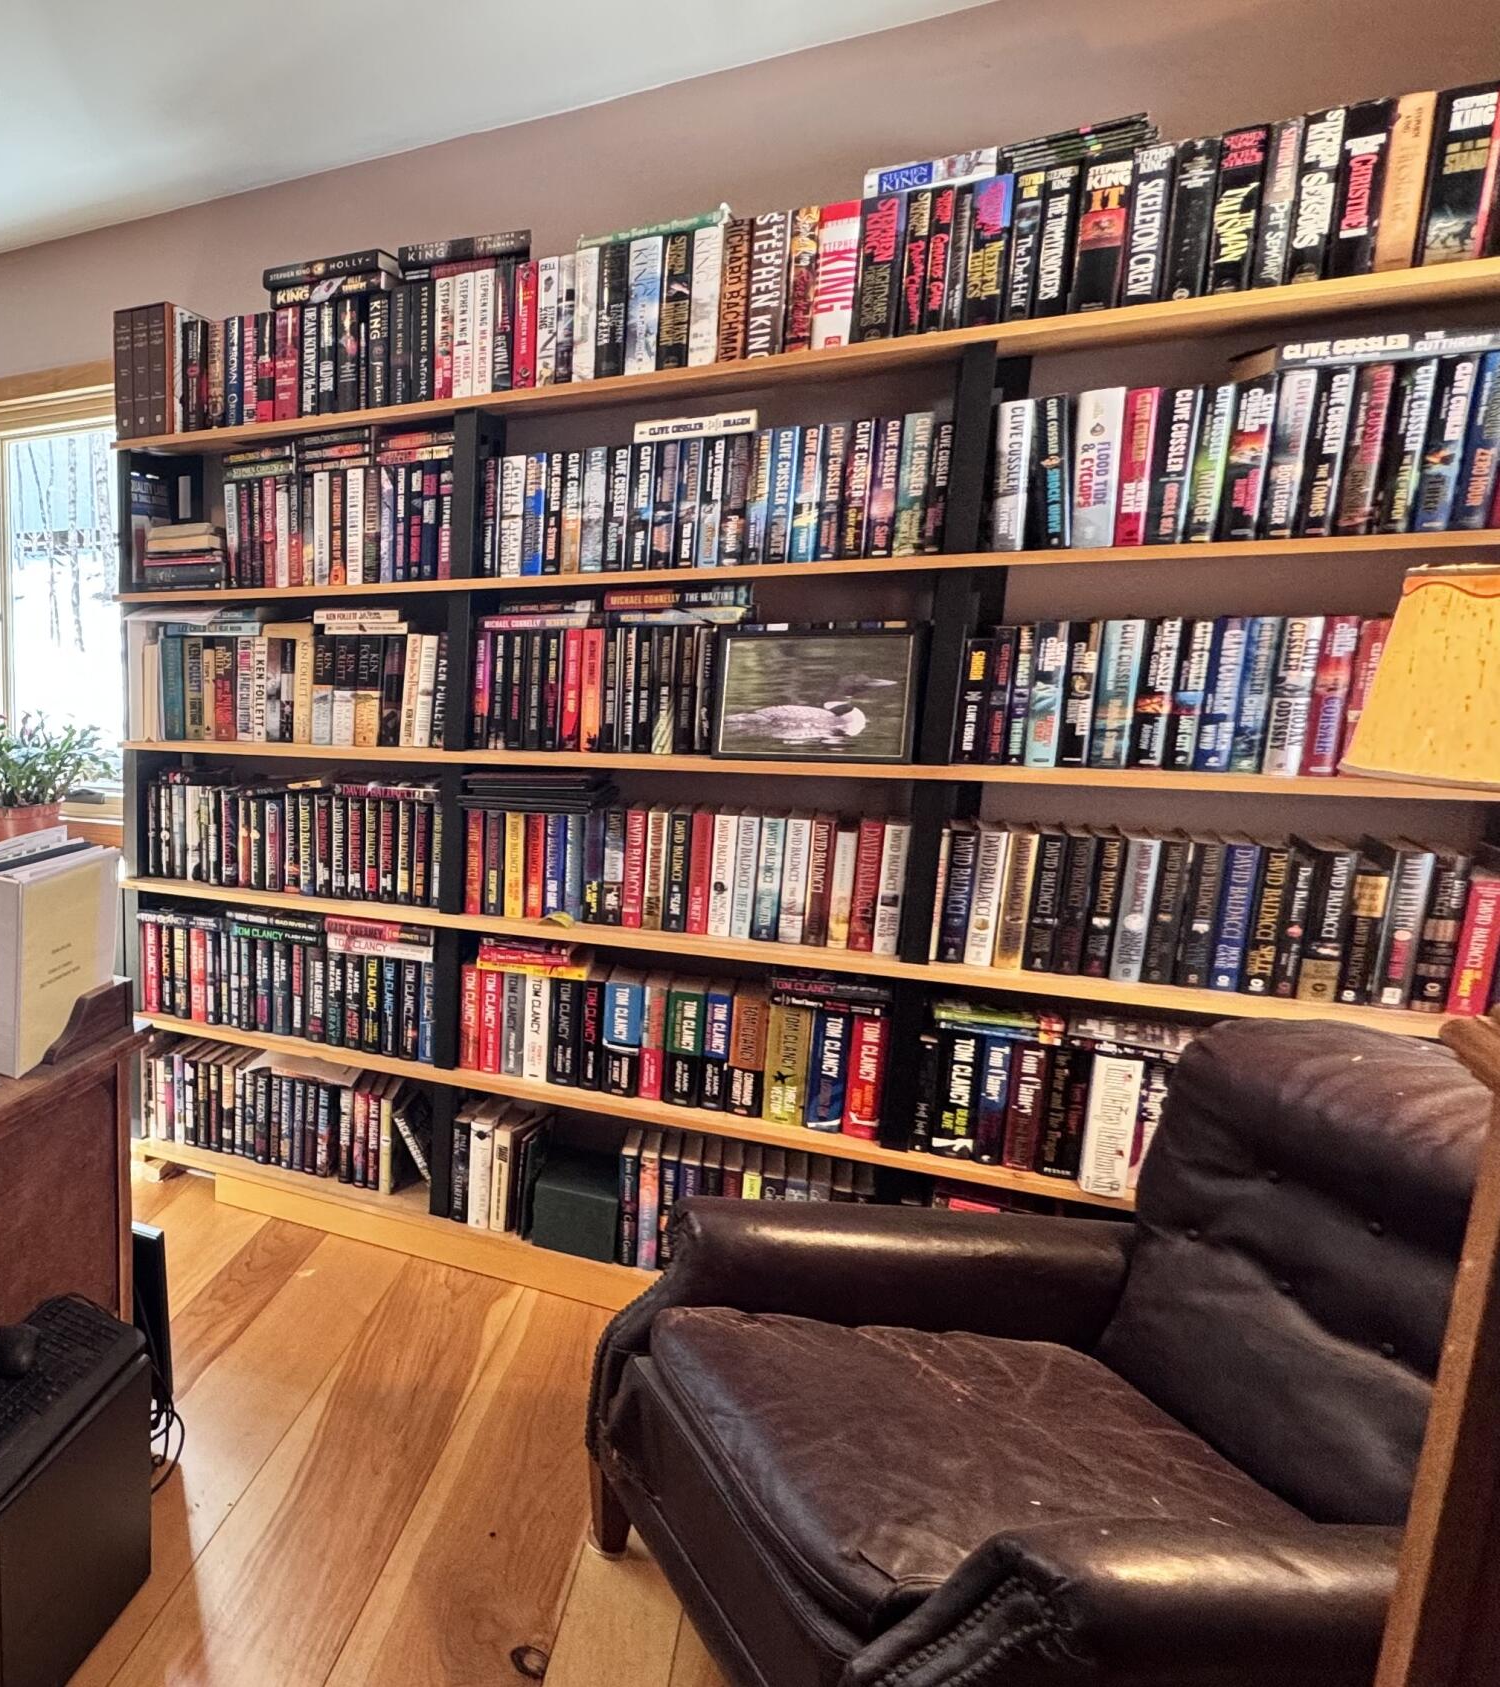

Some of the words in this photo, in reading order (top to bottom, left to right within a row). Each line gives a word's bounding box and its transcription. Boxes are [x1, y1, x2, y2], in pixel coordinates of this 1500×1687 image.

[881, 174, 929, 192] KING
[882, 166, 928, 181] STEPHEN
[1087, 168, 1132, 190] KING
[1090, 186, 1125, 211] IT
[1340, 153, 1378, 230] CHRISTINE
[873, 198, 898, 261] STEPHEN
[1131, 178, 1166, 253] SKELETON
[864, 212, 882, 254] KING
[329, 257, 365, 270] HOLLY
[407, 248, 446, 261] KING
[540, 264, 555, 272] CELL
[724, 219, 743, 287] RICHARD
[1037, 215, 1067, 300] TOMMYKNOCKERS
[814, 250, 857, 314] KING
[967, 249, 983, 299] THINGS
[981, 241, 1005, 299] NEEDFUL
[1127, 254, 1157, 296] CREW
[276, 290, 310, 304] KING
[370, 299, 381, 341] KING
[719, 288, 740, 361] BACHMAN
[494, 335, 509, 379] REVIVAL
[1172, 389, 1193, 421] CLIVE
[1329, 373, 1350, 405] CLIVE
[649, 426, 669, 436] CLIVE
[671, 423, 703, 433] CUSSLER
[780, 431, 793, 459] CLIVE
[855, 421, 870, 450] CLIVE
[887, 420, 900, 447] CLIVE
[615, 449, 628, 475] CLIVE
[1082, 444, 1096, 454] &
[1097, 442, 1111, 477] FLOOD
[1166, 423, 1189, 472] CUSSLER
[1471, 448, 1493, 475] ZERO
[552, 453, 562, 475] CLIVE
[567, 453, 579, 479] CLIVE
[852, 452, 868, 497] CUSSLER
[550, 477, 561, 511] CUSSLER
[612, 476, 626, 517] CUSSLER
[774, 461, 791, 505] CUSSLER
[1076, 458, 1094, 508] CYCLOPS
[1093, 480, 1107, 506] TIDE
[1121, 482, 1136, 513] DEATH
[1193, 468, 1215, 523] MIRAGE
[1271, 464, 1293, 524] BOOTLEGGER
[1308, 478, 1332, 517] TOMBS
[1465, 476, 1489, 506] HOUR
[607, 522, 618, 560] ASSASSIN
[725, 515, 739, 552] PIRANHA
[611, 595, 642, 605] MICHAEL
[644, 593, 680, 603] CONNELLY
[685, 593, 698, 602] THE
[701, 592, 734, 601] WAITING
[485, 620, 509, 628] MICHAEL
[511, 619, 541, 627] CONNELLY
[1162, 621, 1181, 650] CLIVE
[359, 644, 369, 681] FOLLETT
[370, 653, 378, 672] KEN
[1220, 629, 1245, 665] CLIVE
[256, 660, 265, 679] KEN
[1155, 650, 1175, 692] CUSSLER
[255, 684, 264, 727] FOLLETT
[966, 705, 978, 722] CLIVE
[962, 724, 976, 751] CUSSLER
[1179, 715, 1195, 734] LOST
[1270, 701, 1292, 750] ODYSSEY
[1288, 702, 1308, 747] TROJAN
[1175, 735, 1191, 752] CITY
[300, 806, 310, 830] DAVID
[335, 809, 343, 831] DAVID
[630, 815, 644, 844] DAVID
[674, 820, 686, 843] DAVID
[741, 820, 754, 845] DAVID
[334, 833, 343, 870] BALDACCI
[815, 824, 829, 850] DAVID
[862, 827, 880, 859] DAVID
[953, 836, 975, 865] DAVID
[984, 836, 1000, 866] DAVID
[671, 845, 684, 881] BALDACCI
[739, 847, 752, 889] BALDACCI
[1044, 841, 1060, 868] DAVID
[1103, 841, 1120, 868] DAVID
[1232, 850, 1254, 882] DAVID
[1267, 853, 1288, 885] DAVID
[627, 849, 640, 895] BALDACCI
[811, 852, 826, 892] BALDACCI
[1331, 856, 1350, 887] DAVID
[737, 893, 748, 908] THE
[855, 863, 877, 918] BALDACCI
[946, 868, 971, 914] BALDACCI
[975, 866, 995, 917] BALDACCI
[1037, 871, 1056, 914] BALDACCI
[1451, 879, 1466, 908] DAVID
[735, 909, 747, 922] HIT
[1222, 886, 1248, 938] BALDACCI
[1255, 888, 1283, 940] BALDACCI
[1321, 890, 1345, 938] BALDACCI
[235, 927, 250, 937] TOM
[251, 928, 284, 940] CLANCY
[314, 962, 323, 982] MARK
[368, 959, 377, 976] TOM
[1260, 945, 1276, 976] SPLIT
[367, 978, 377, 1012] CLANCY
[485, 973, 496, 991] TOM
[532, 979, 542, 997] TOM
[560, 982, 571, 1002] TOM
[615, 988, 629, 1006] TOM
[313, 984, 322, 1018] GREANEY
[484, 993, 496, 1028] CLANCY
[530, 999, 541, 1035] CLANCY
[683, 1001, 697, 1018] TOM
[714, 1004, 727, 1020] TOM
[558, 1003, 570, 1040] CLANCY
[613, 1007, 629, 1041] CLANCY
[680, 1020, 696, 1051] CLANCY
[786, 1012, 800, 1032] TOM
[825, 1017, 843, 1037] TOM
[863, 1022, 879, 1042] TOM
[711, 1023, 726, 1055] CLANCY
[782, 1034, 798, 1071] CLANCY
[953, 1039, 975, 1062] TOM
[821, 1040, 841, 1077] CLANCY
[859, 1045, 878, 1082] CLANCY
[989, 1045, 1011, 1068] Tom
[1022, 1050, 1045, 1074] Tom
[731, 1069, 743, 1105] AUTHORITY
[742, 1073, 754, 1106] COMMAND
[770, 1086, 782, 1114] VECTOR
[785, 1086, 796, 1113] THREAT
[949, 1064, 972, 1106] CLANCY
[981, 1069, 1007, 1101] Clancy
[1012, 1077, 1041, 1116] Clancy
[956, 1108, 968, 1124] DEAD
[397, 1117, 410, 1134] JACK
[407, 1134, 426, 1172] HIGGINS
[453, 1175, 463, 1208] STARFIRE
